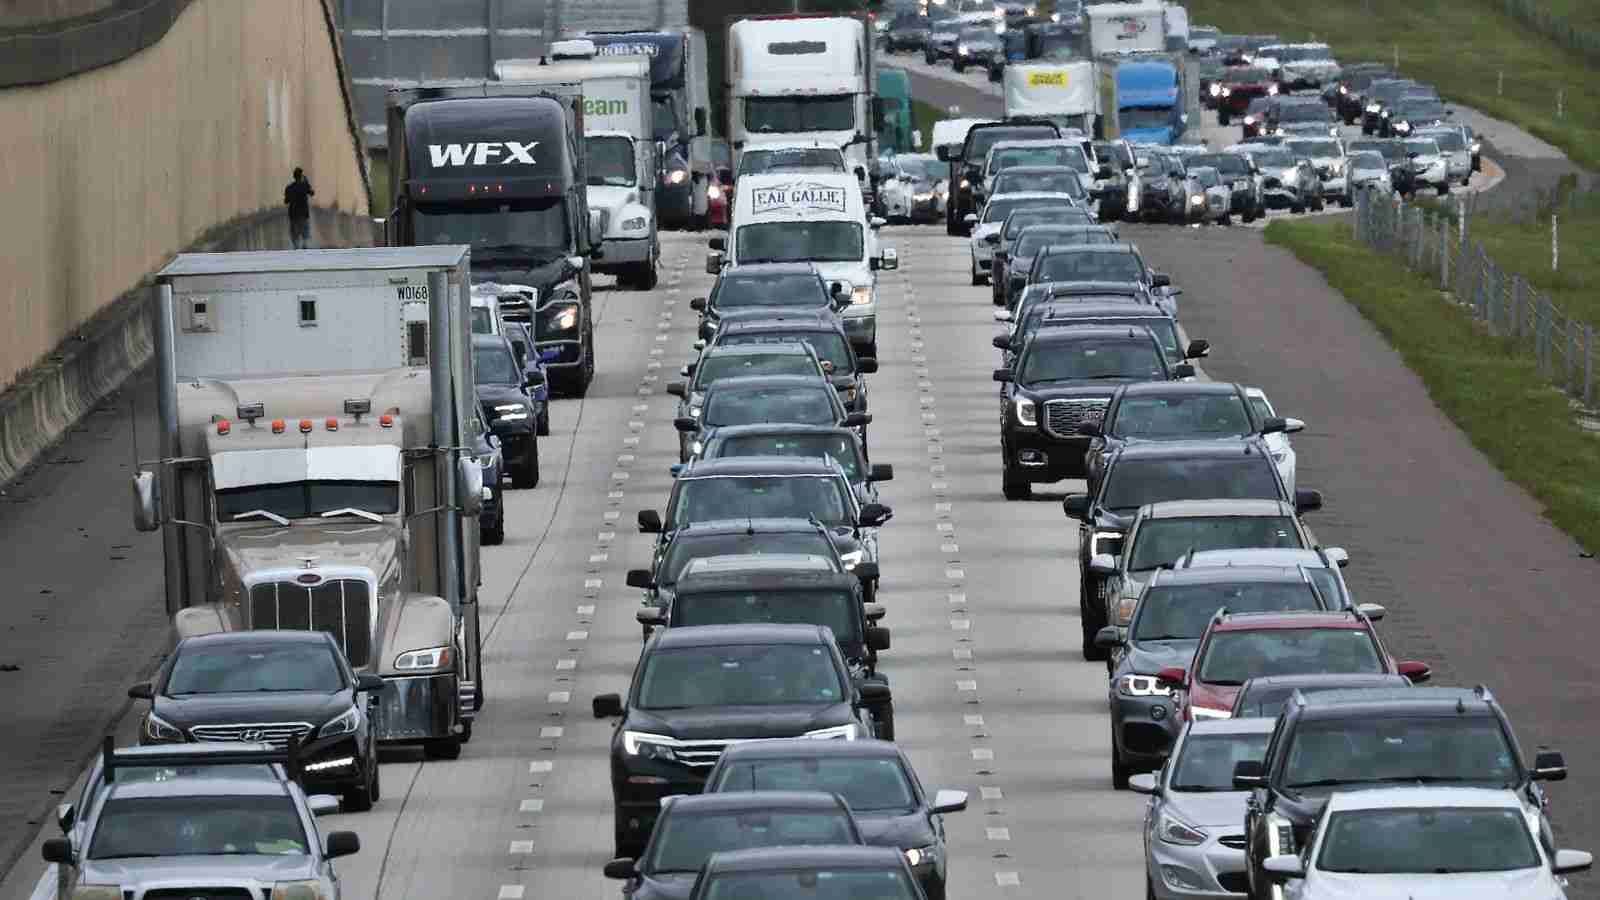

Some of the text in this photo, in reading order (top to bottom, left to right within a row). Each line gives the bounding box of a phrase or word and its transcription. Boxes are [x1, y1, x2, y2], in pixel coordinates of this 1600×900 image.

[582, 97, 628, 116] eam
[428, 141, 540, 168] WFX
[758, 191, 785, 205] EAU
